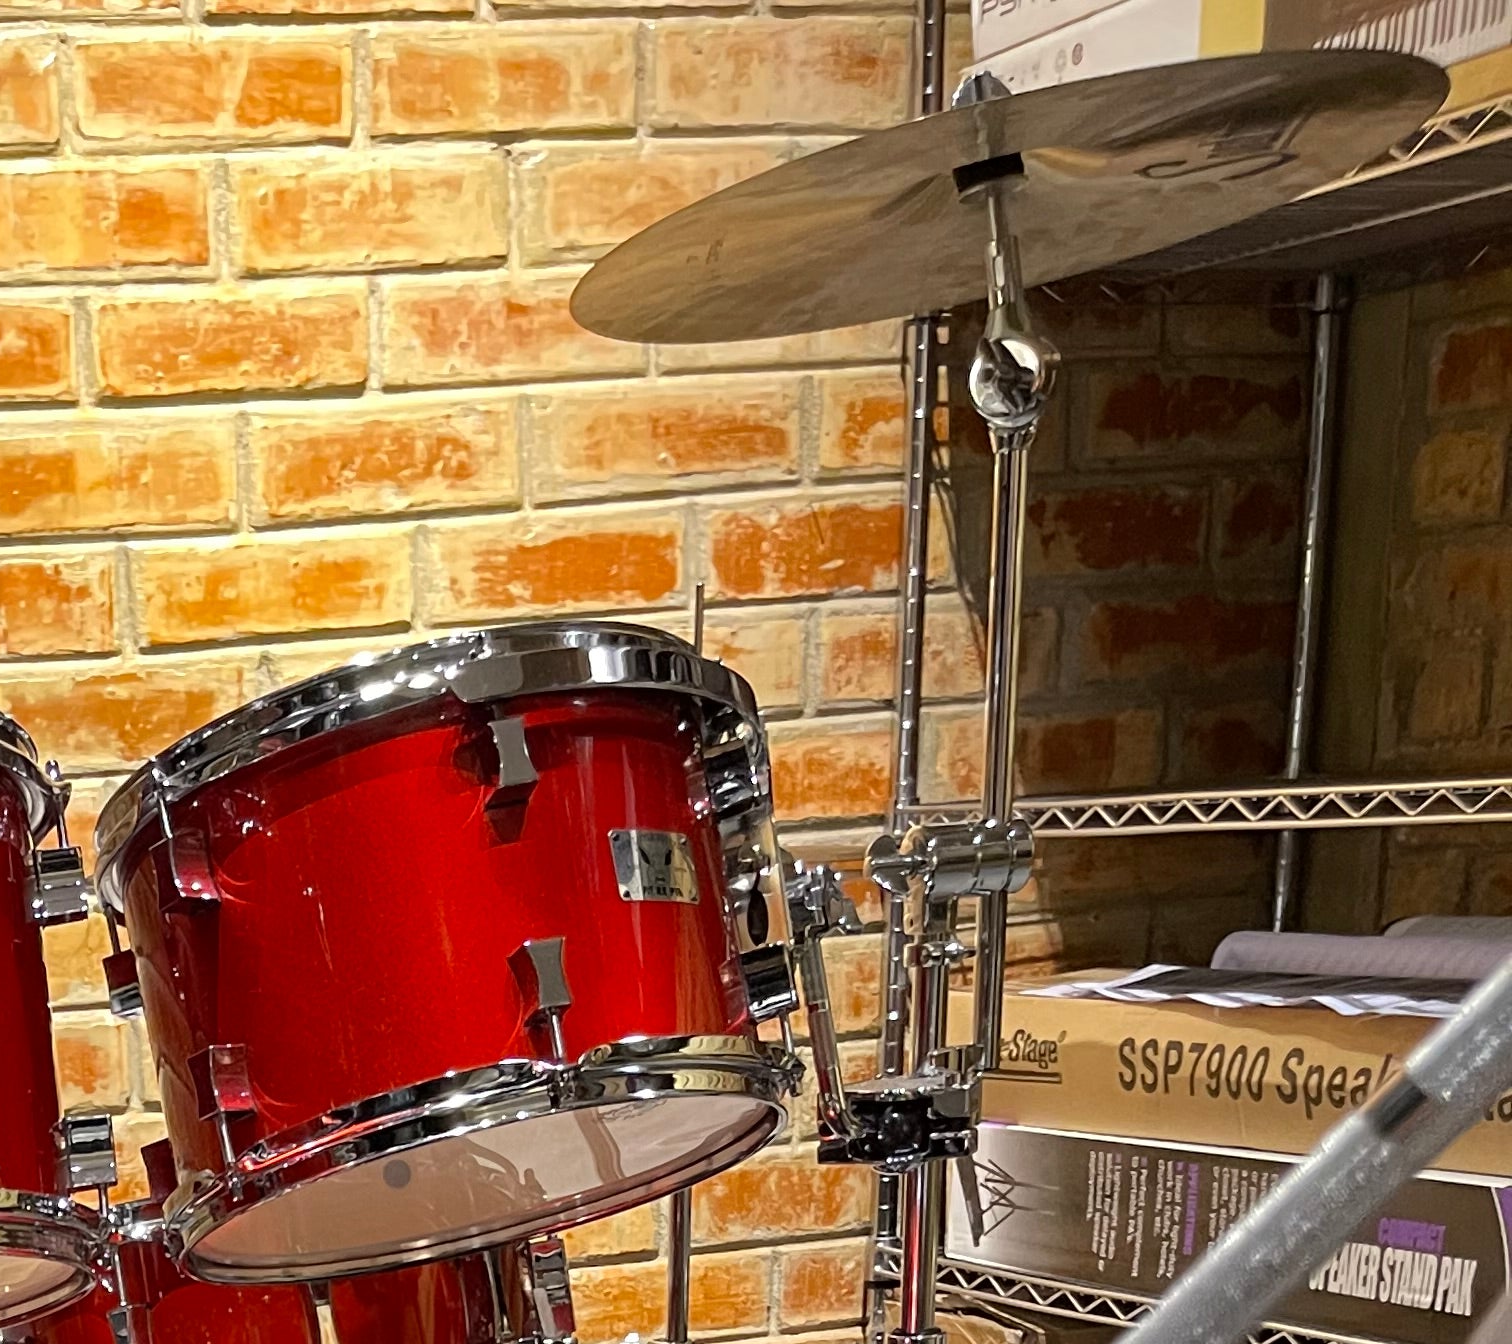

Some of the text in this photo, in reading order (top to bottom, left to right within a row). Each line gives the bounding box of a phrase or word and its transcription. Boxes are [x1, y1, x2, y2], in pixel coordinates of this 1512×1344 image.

[1118, 1037, 1271, 1101] SSP7900
[1379, 1247, 1439, 1310] STAND
[1434, 1256, 1477, 1316] PAK
